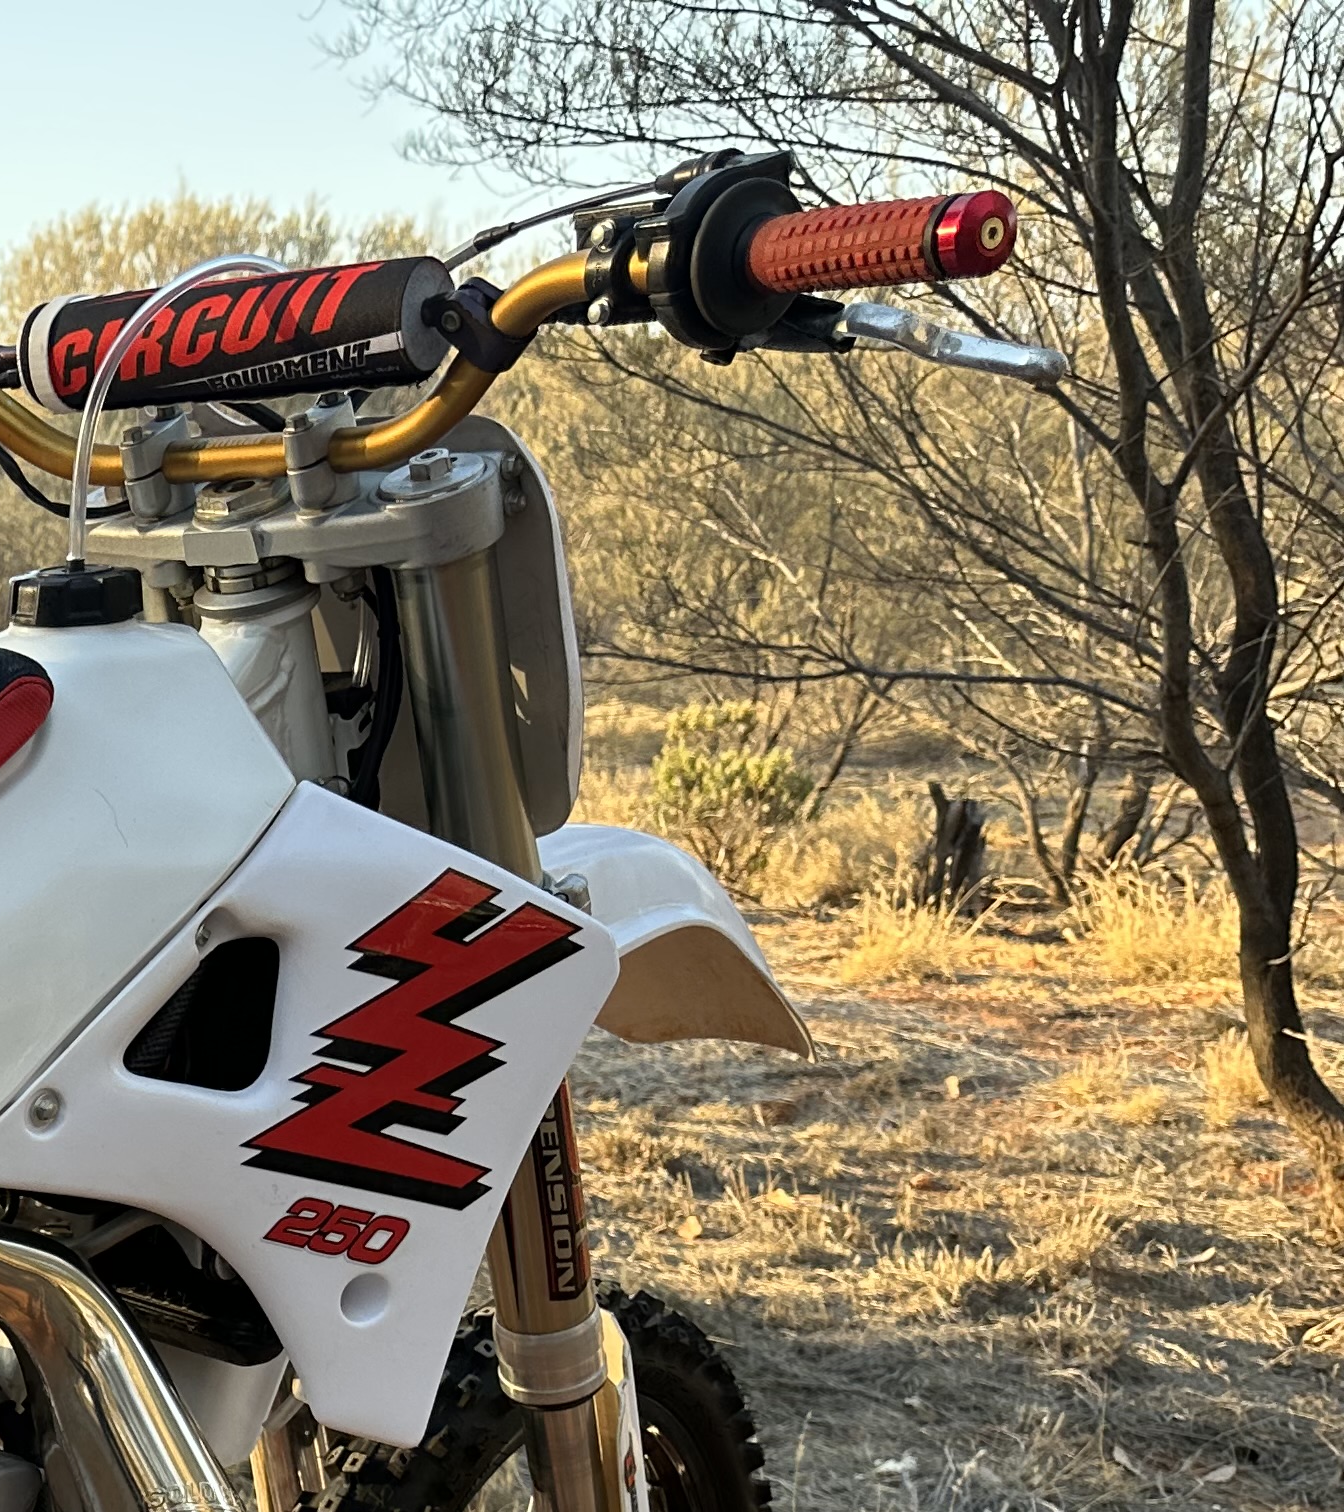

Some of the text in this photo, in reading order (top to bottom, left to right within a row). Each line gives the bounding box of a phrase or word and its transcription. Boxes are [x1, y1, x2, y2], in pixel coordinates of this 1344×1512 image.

[51, 262, 384, 397] CIRCUIT
[206, 340, 371, 391] EQUIPMENT
[263, 1197, 411, 1266] 250
